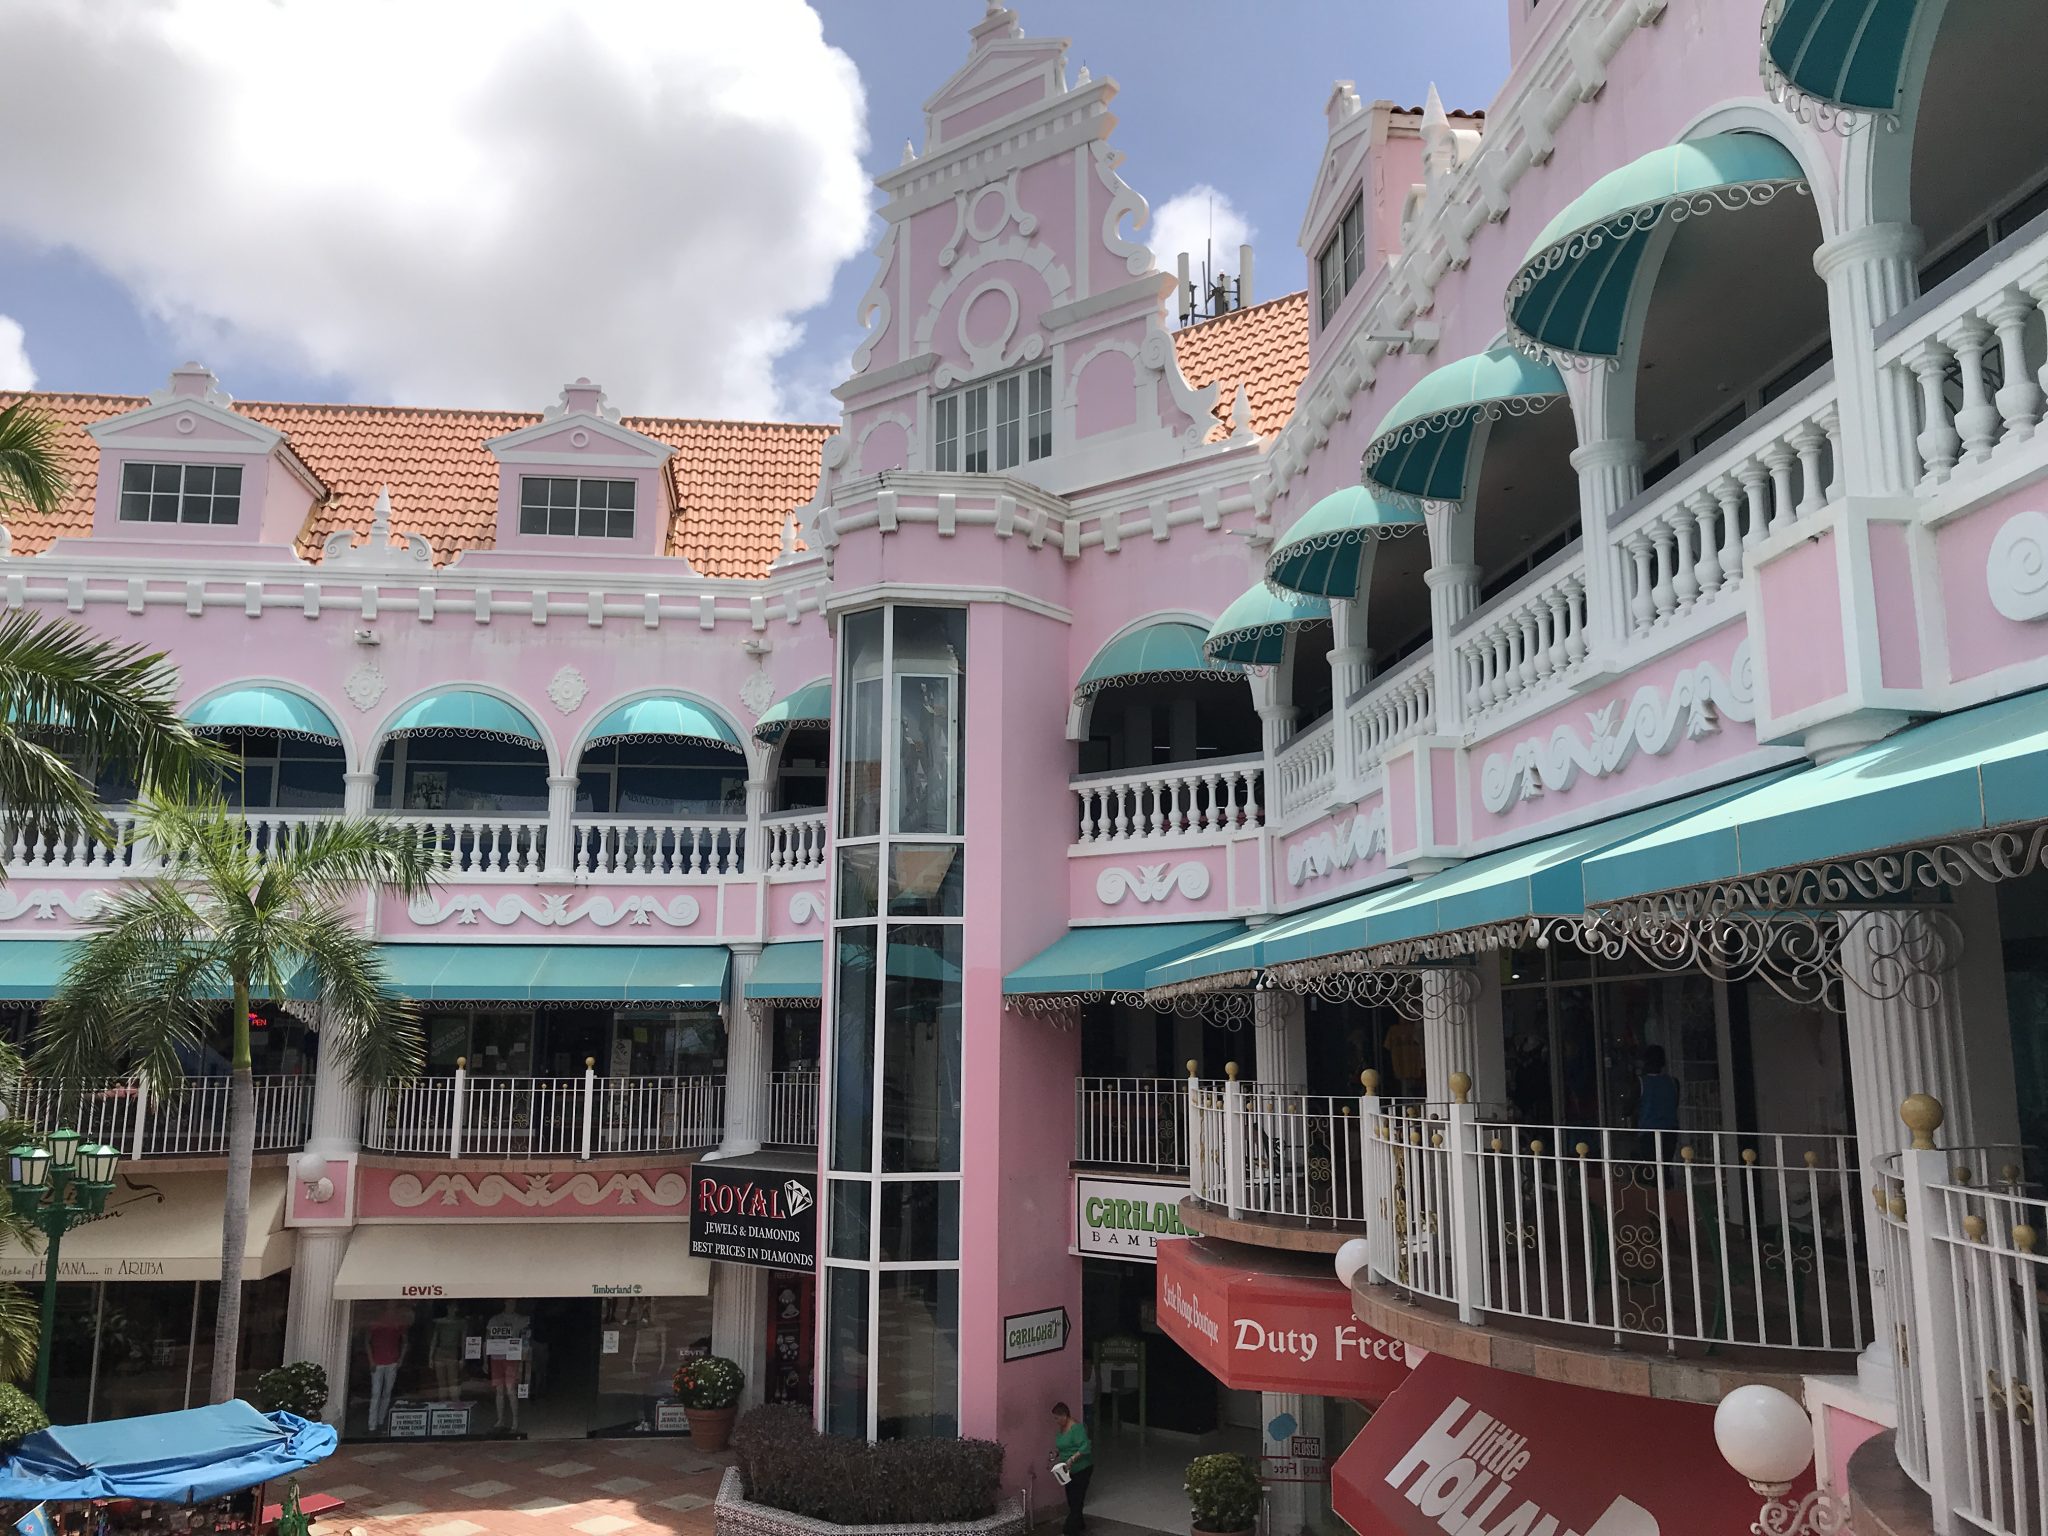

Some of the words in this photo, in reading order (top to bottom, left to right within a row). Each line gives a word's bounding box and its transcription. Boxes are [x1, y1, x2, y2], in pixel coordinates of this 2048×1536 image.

[699, 1178, 786, 1219] ROYAL
[704, 1221, 738, 1236] JEWELS
[739, 1225, 747, 1237] &
[748, 1226, 800, 1243] DIAMONDS
[1092, 1231, 1157, 1248] BAMB
[692, 1241, 714, 1254] BEST
[715, 1243, 746, 1259] PRICES
[747, 1247, 759, 1260] IN
[760, 1248, 814, 1267] DIAMONDS
[0, 1265, 22, 1276] aste
[104, 1264, 113, 1275] in
[118, 1259, 164, 1275] ARUBA
[592, 1284, 632, 1295] Timberland
[492, 1327, 511, 1335] OPEN
[1233, 1318, 1318, 1362] Duty
[1334, 1325, 1404, 1361] Free
[1293, 1442, 1319, 1457] CLOSED
